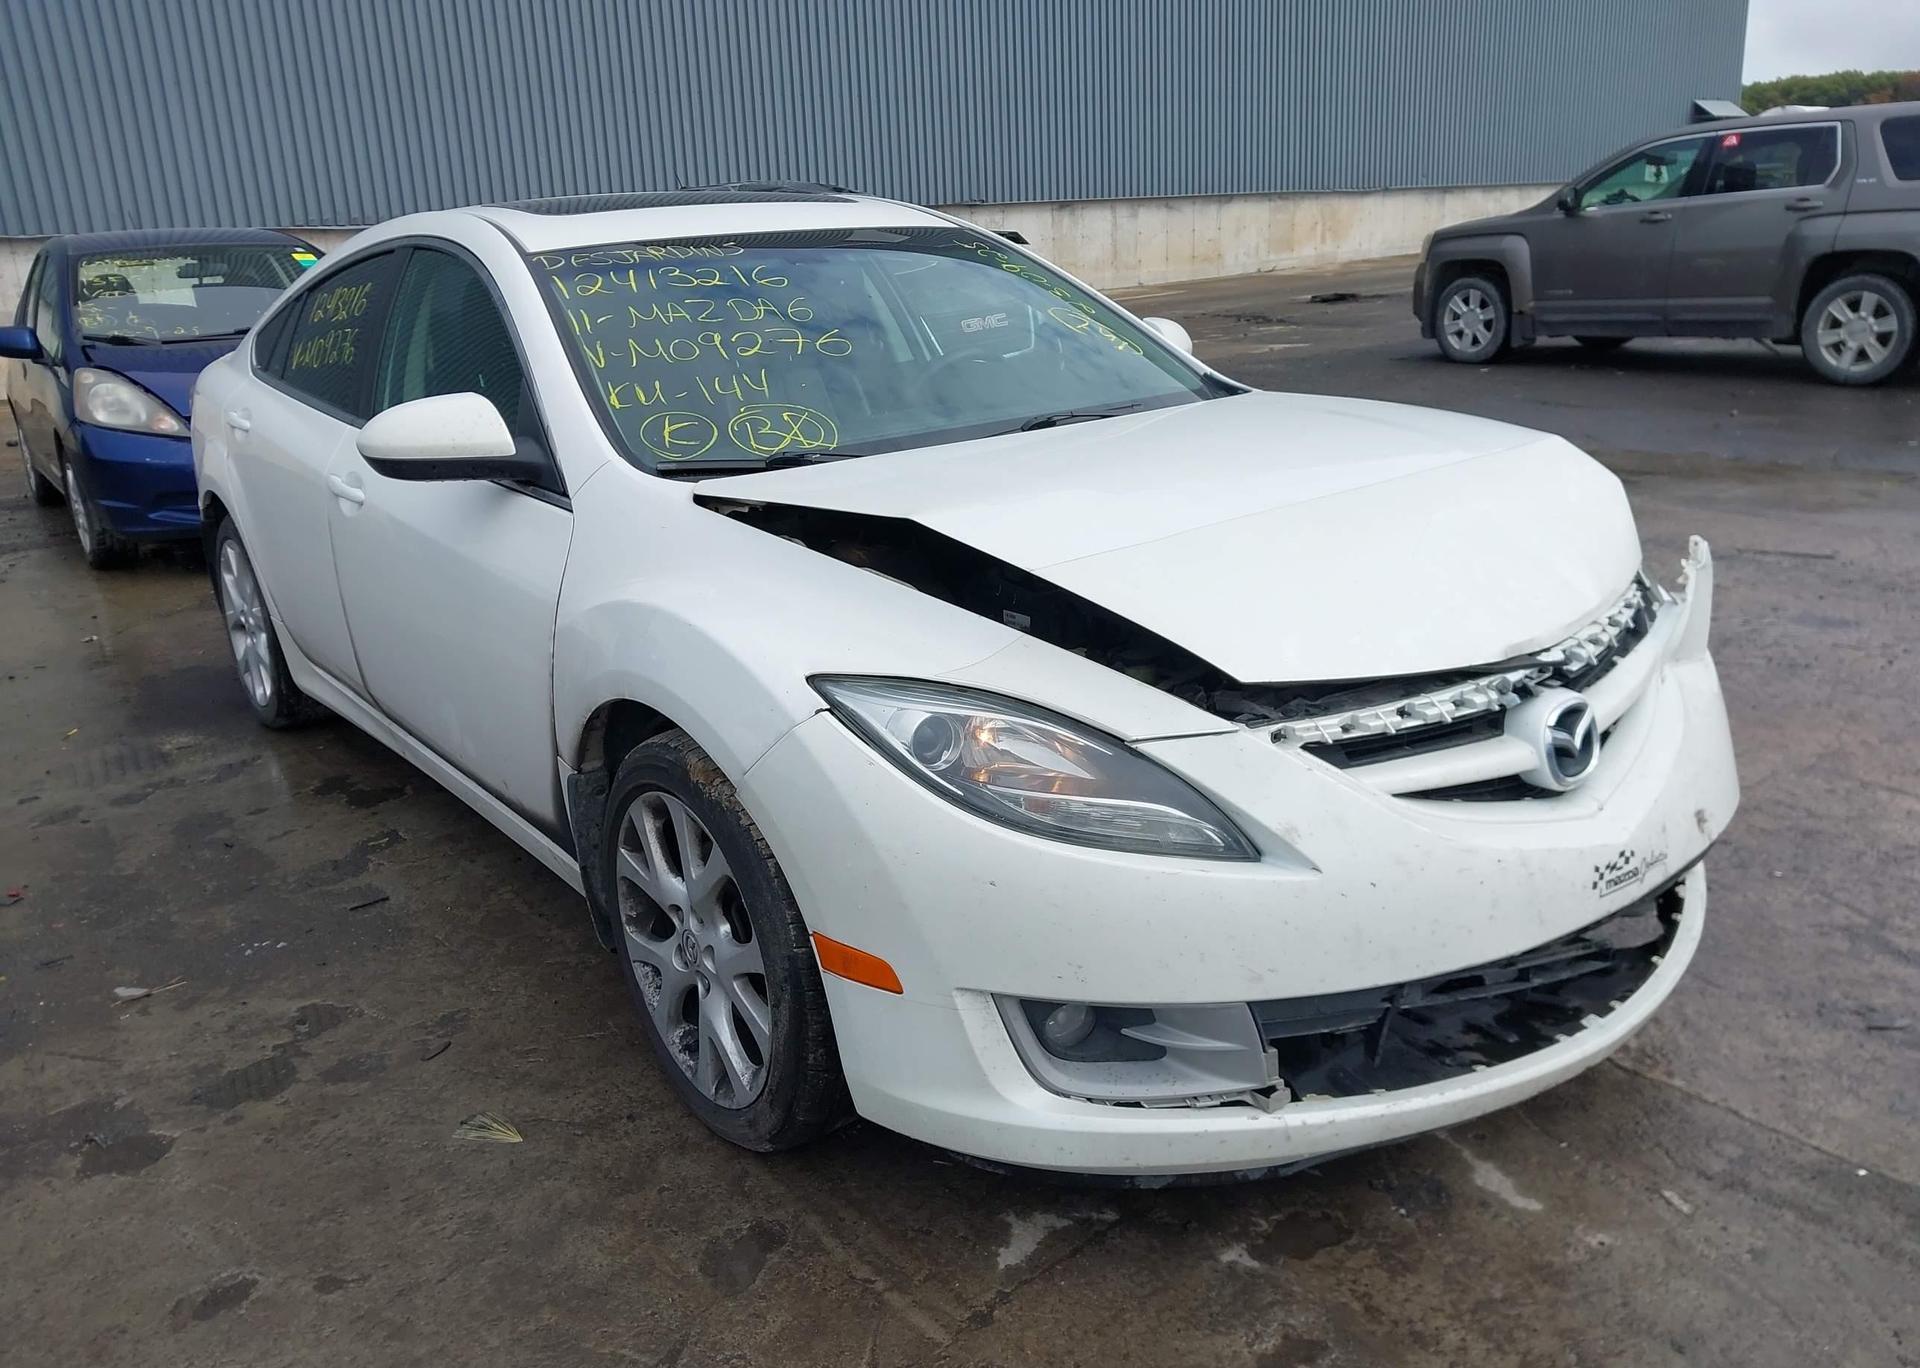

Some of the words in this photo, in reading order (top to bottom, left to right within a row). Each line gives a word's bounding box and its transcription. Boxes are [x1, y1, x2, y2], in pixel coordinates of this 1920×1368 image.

[532, 242, 744, 270] DESJARDINS
[552, 264, 789, 299] 12413216
[961, 312, 1009, 333] GMC
